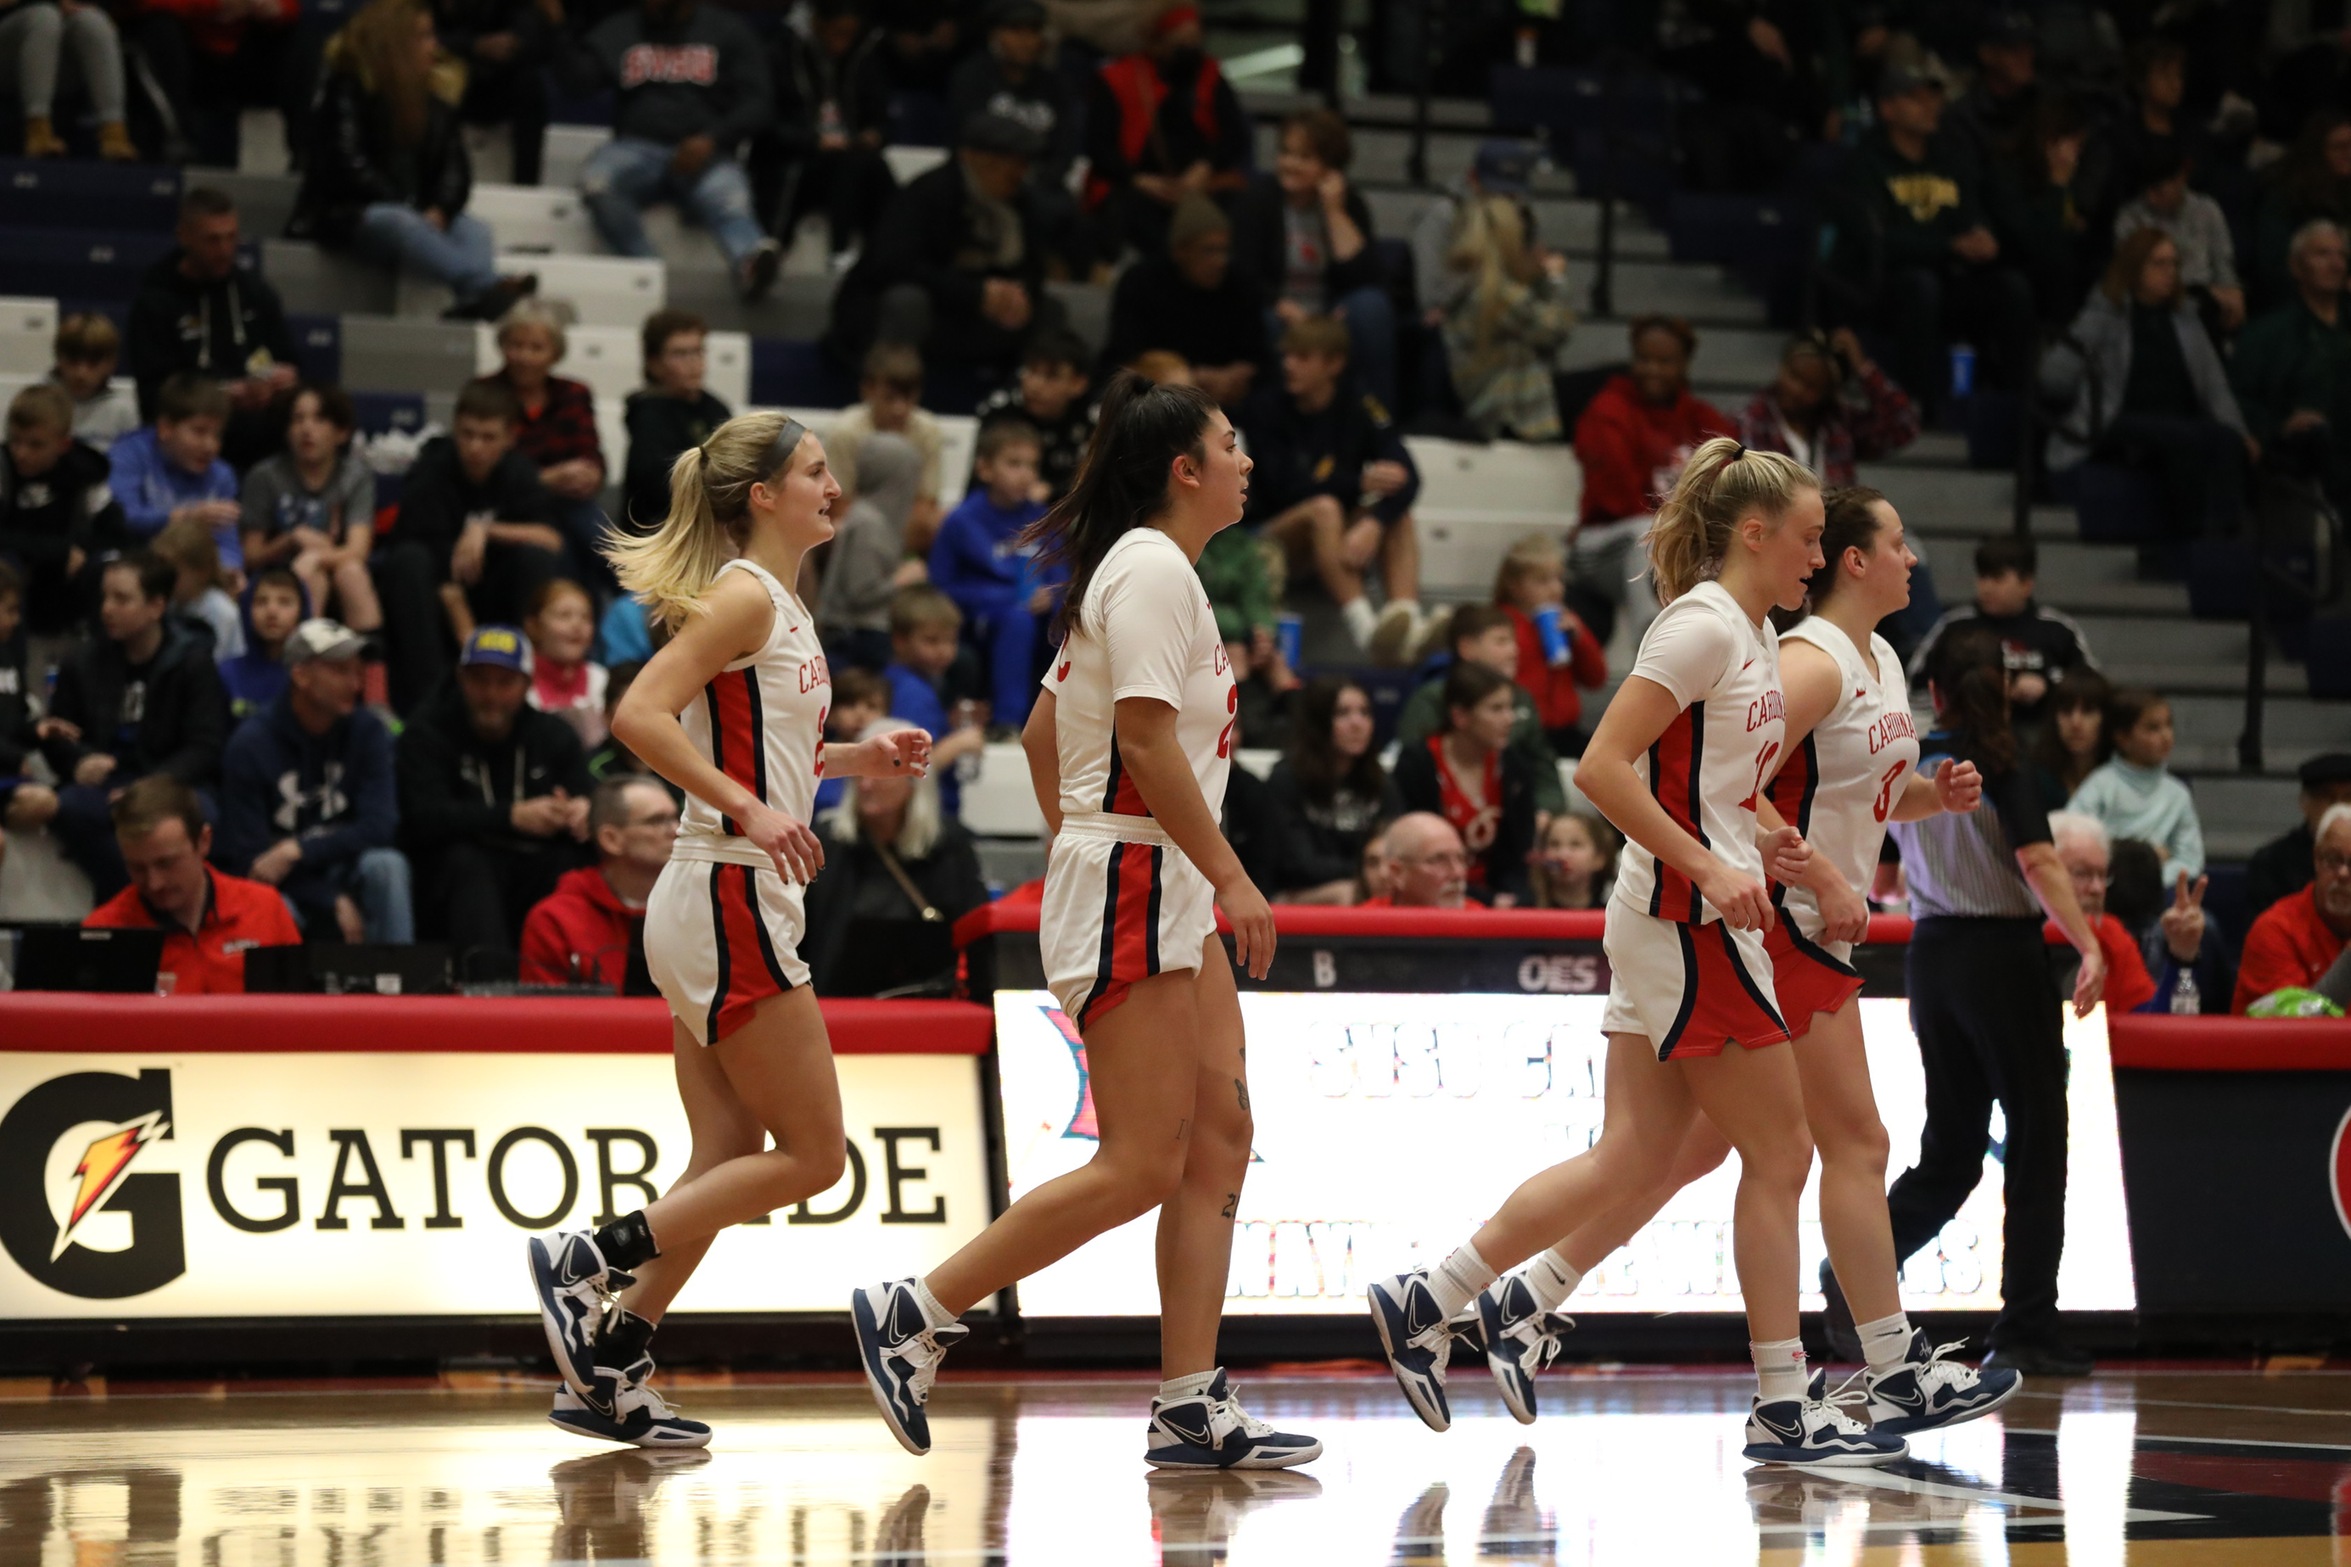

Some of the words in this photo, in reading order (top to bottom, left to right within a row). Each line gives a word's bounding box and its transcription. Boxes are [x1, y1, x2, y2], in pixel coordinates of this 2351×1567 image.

[1869, 712, 1918, 755] CARDINA
[1873, 759, 1907, 823] 3
[0, 1068, 187, 1300] G
[206, 1126, 947, 1234] GATORDE
